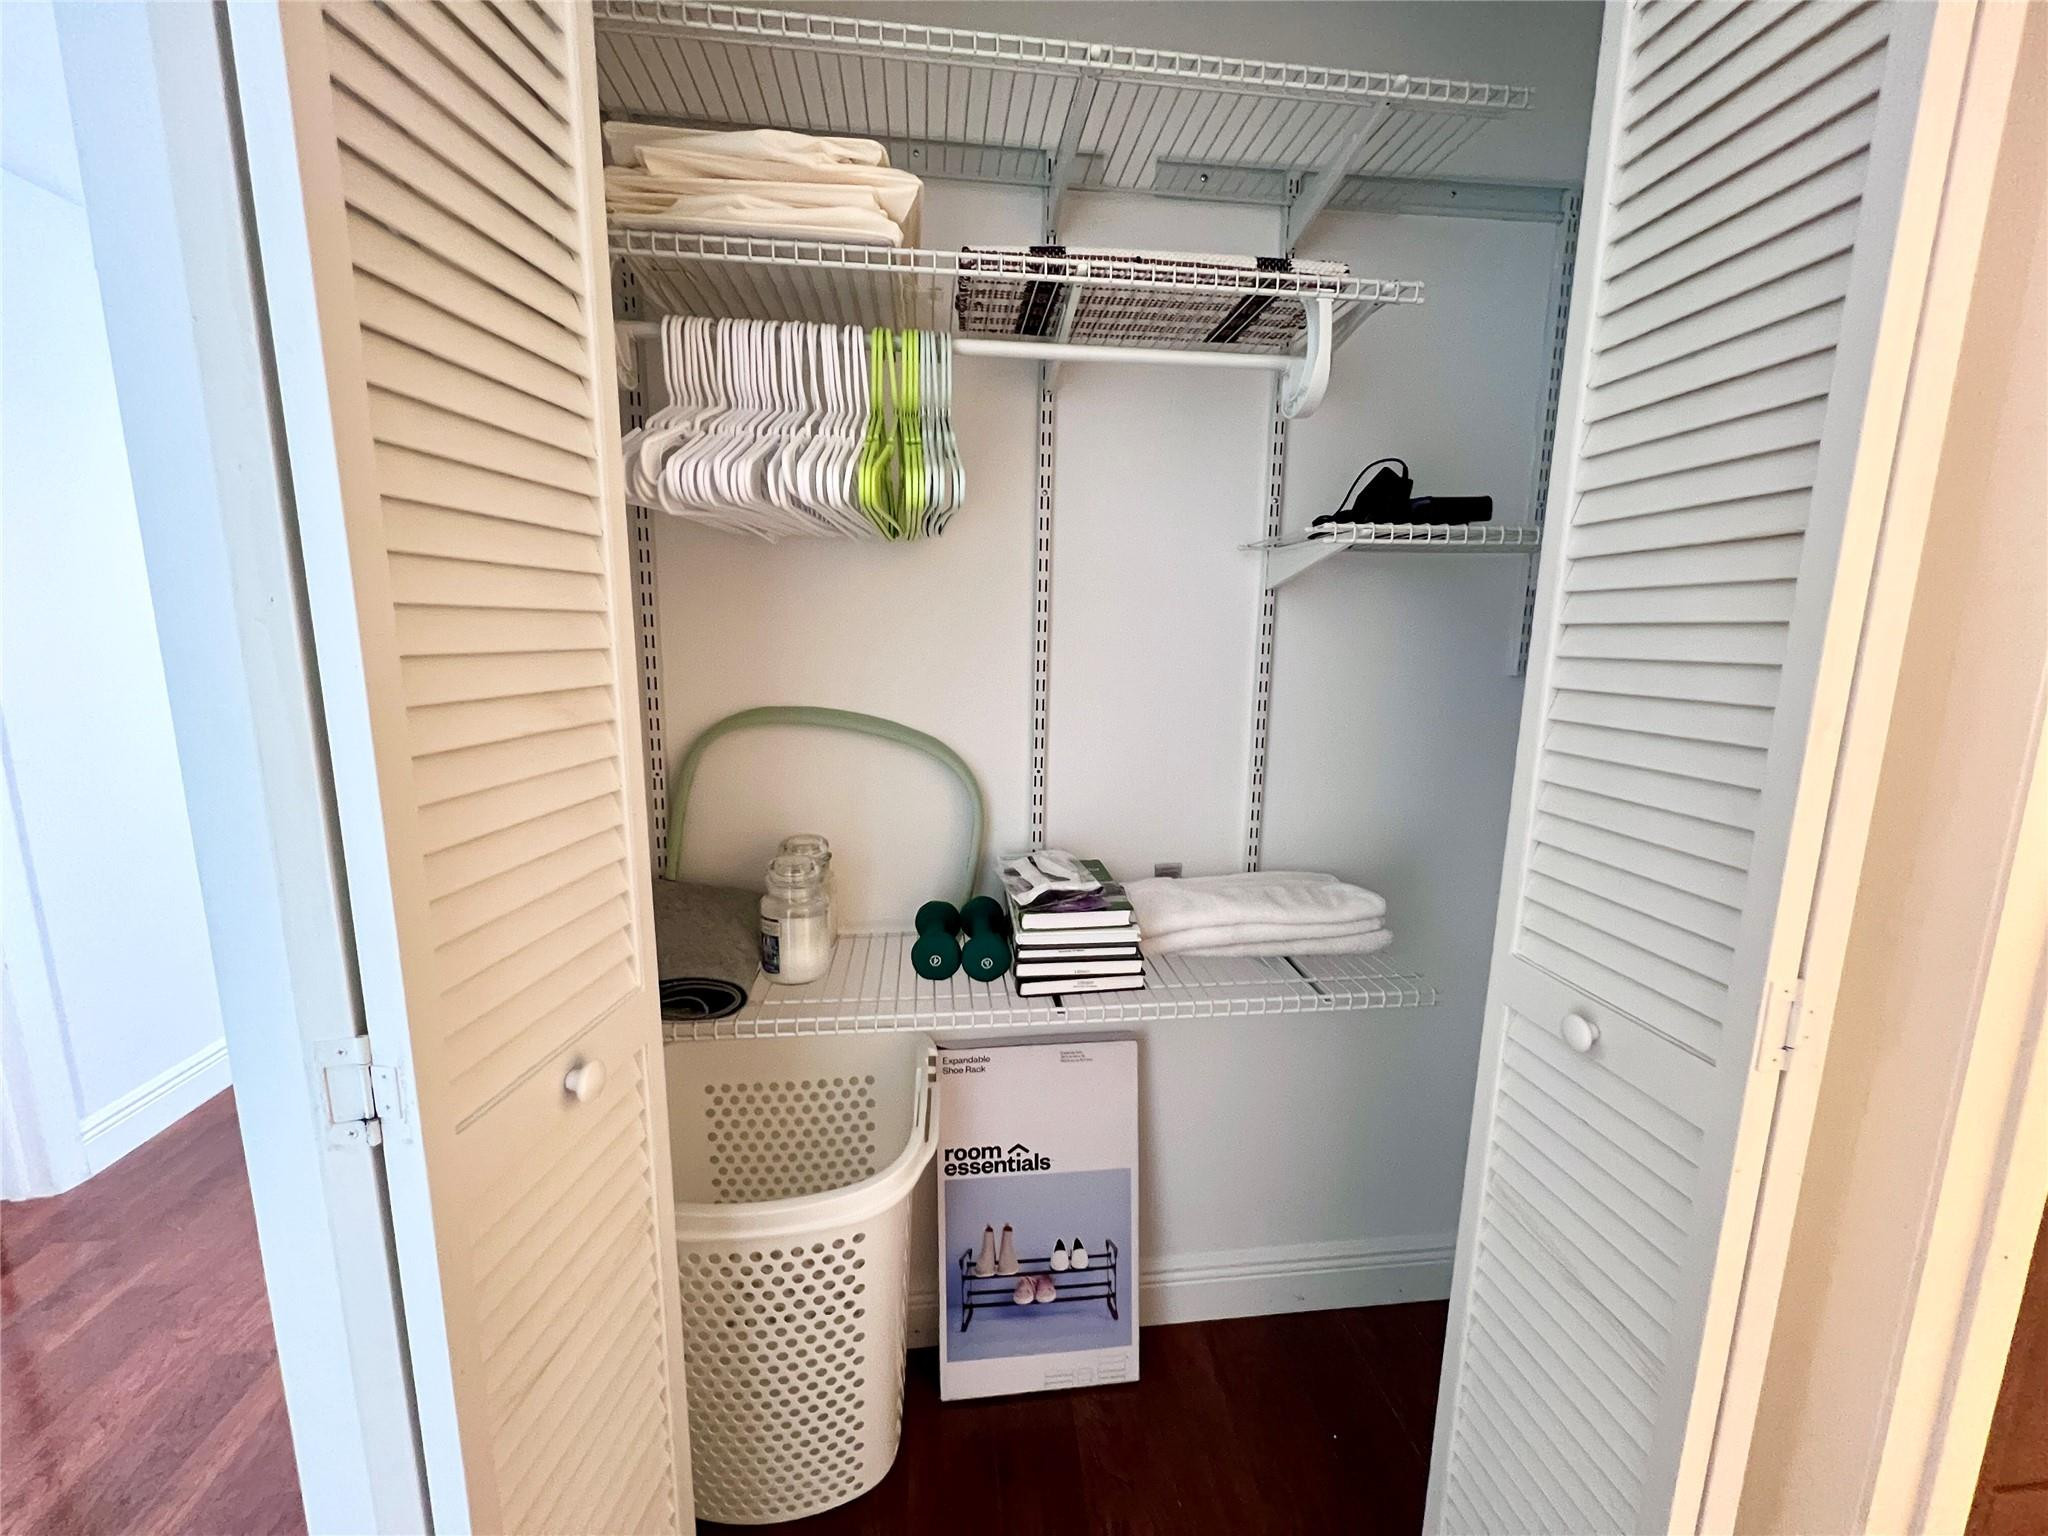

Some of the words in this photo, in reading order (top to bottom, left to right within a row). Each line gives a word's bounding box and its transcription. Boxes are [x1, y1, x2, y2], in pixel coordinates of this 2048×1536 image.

[942, 1055, 991, 1066] Expandable
[942, 1066, 964, 1075] Shoe
[965, 1065, 986, 1073] Rack
[944, 1145, 1001, 1161] room
[944, 1153, 1051, 1176] essentials
